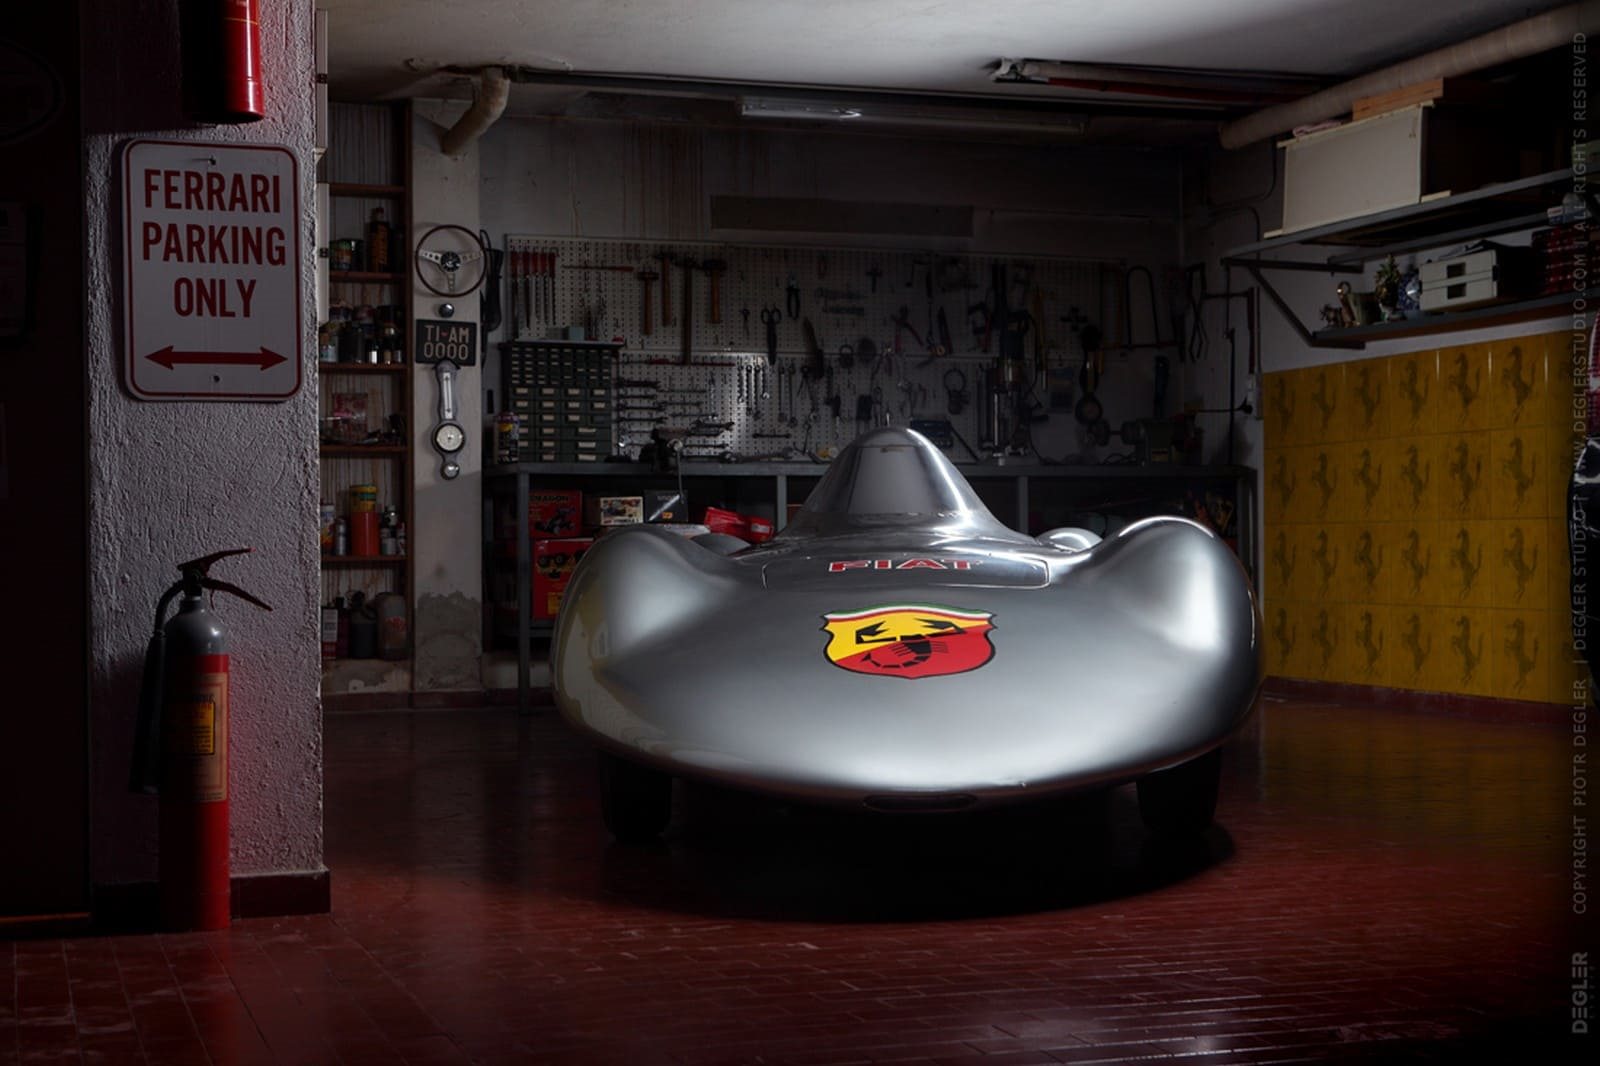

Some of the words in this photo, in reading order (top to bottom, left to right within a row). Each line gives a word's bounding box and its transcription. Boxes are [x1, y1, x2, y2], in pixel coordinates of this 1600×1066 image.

[144, 169, 281, 213] FERRARI
[143, 222, 286, 266] PARKING
[174, 277, 257, 318] ONLY
[828, 558, 983, 573] FIAT
